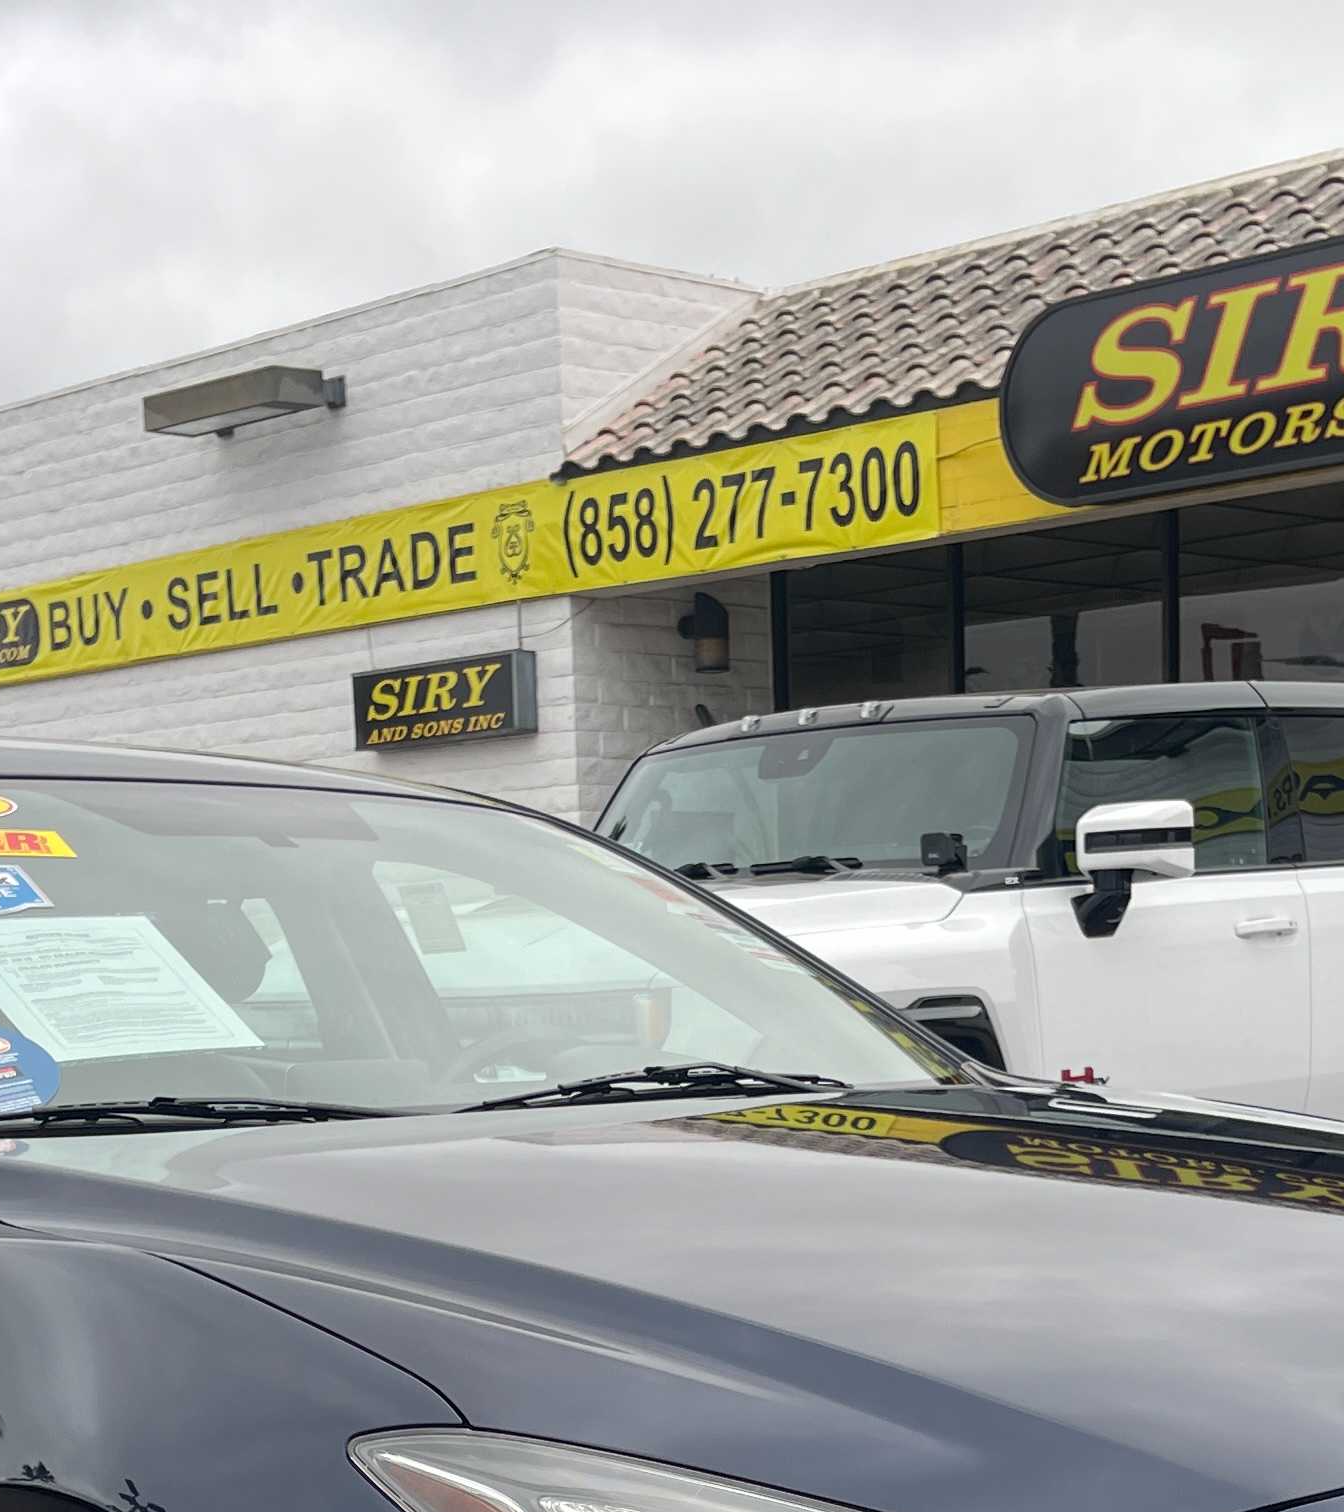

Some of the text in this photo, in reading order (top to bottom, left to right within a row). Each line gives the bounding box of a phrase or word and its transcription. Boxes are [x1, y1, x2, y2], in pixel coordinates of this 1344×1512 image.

[563, 440, 920, 578] (858) 277-7300
[50, 523, 476, 651] BUY SELL TRADE
[366, 662, 501, 721] SIRY
[367, 711, 505, 744] AND SONS INC
